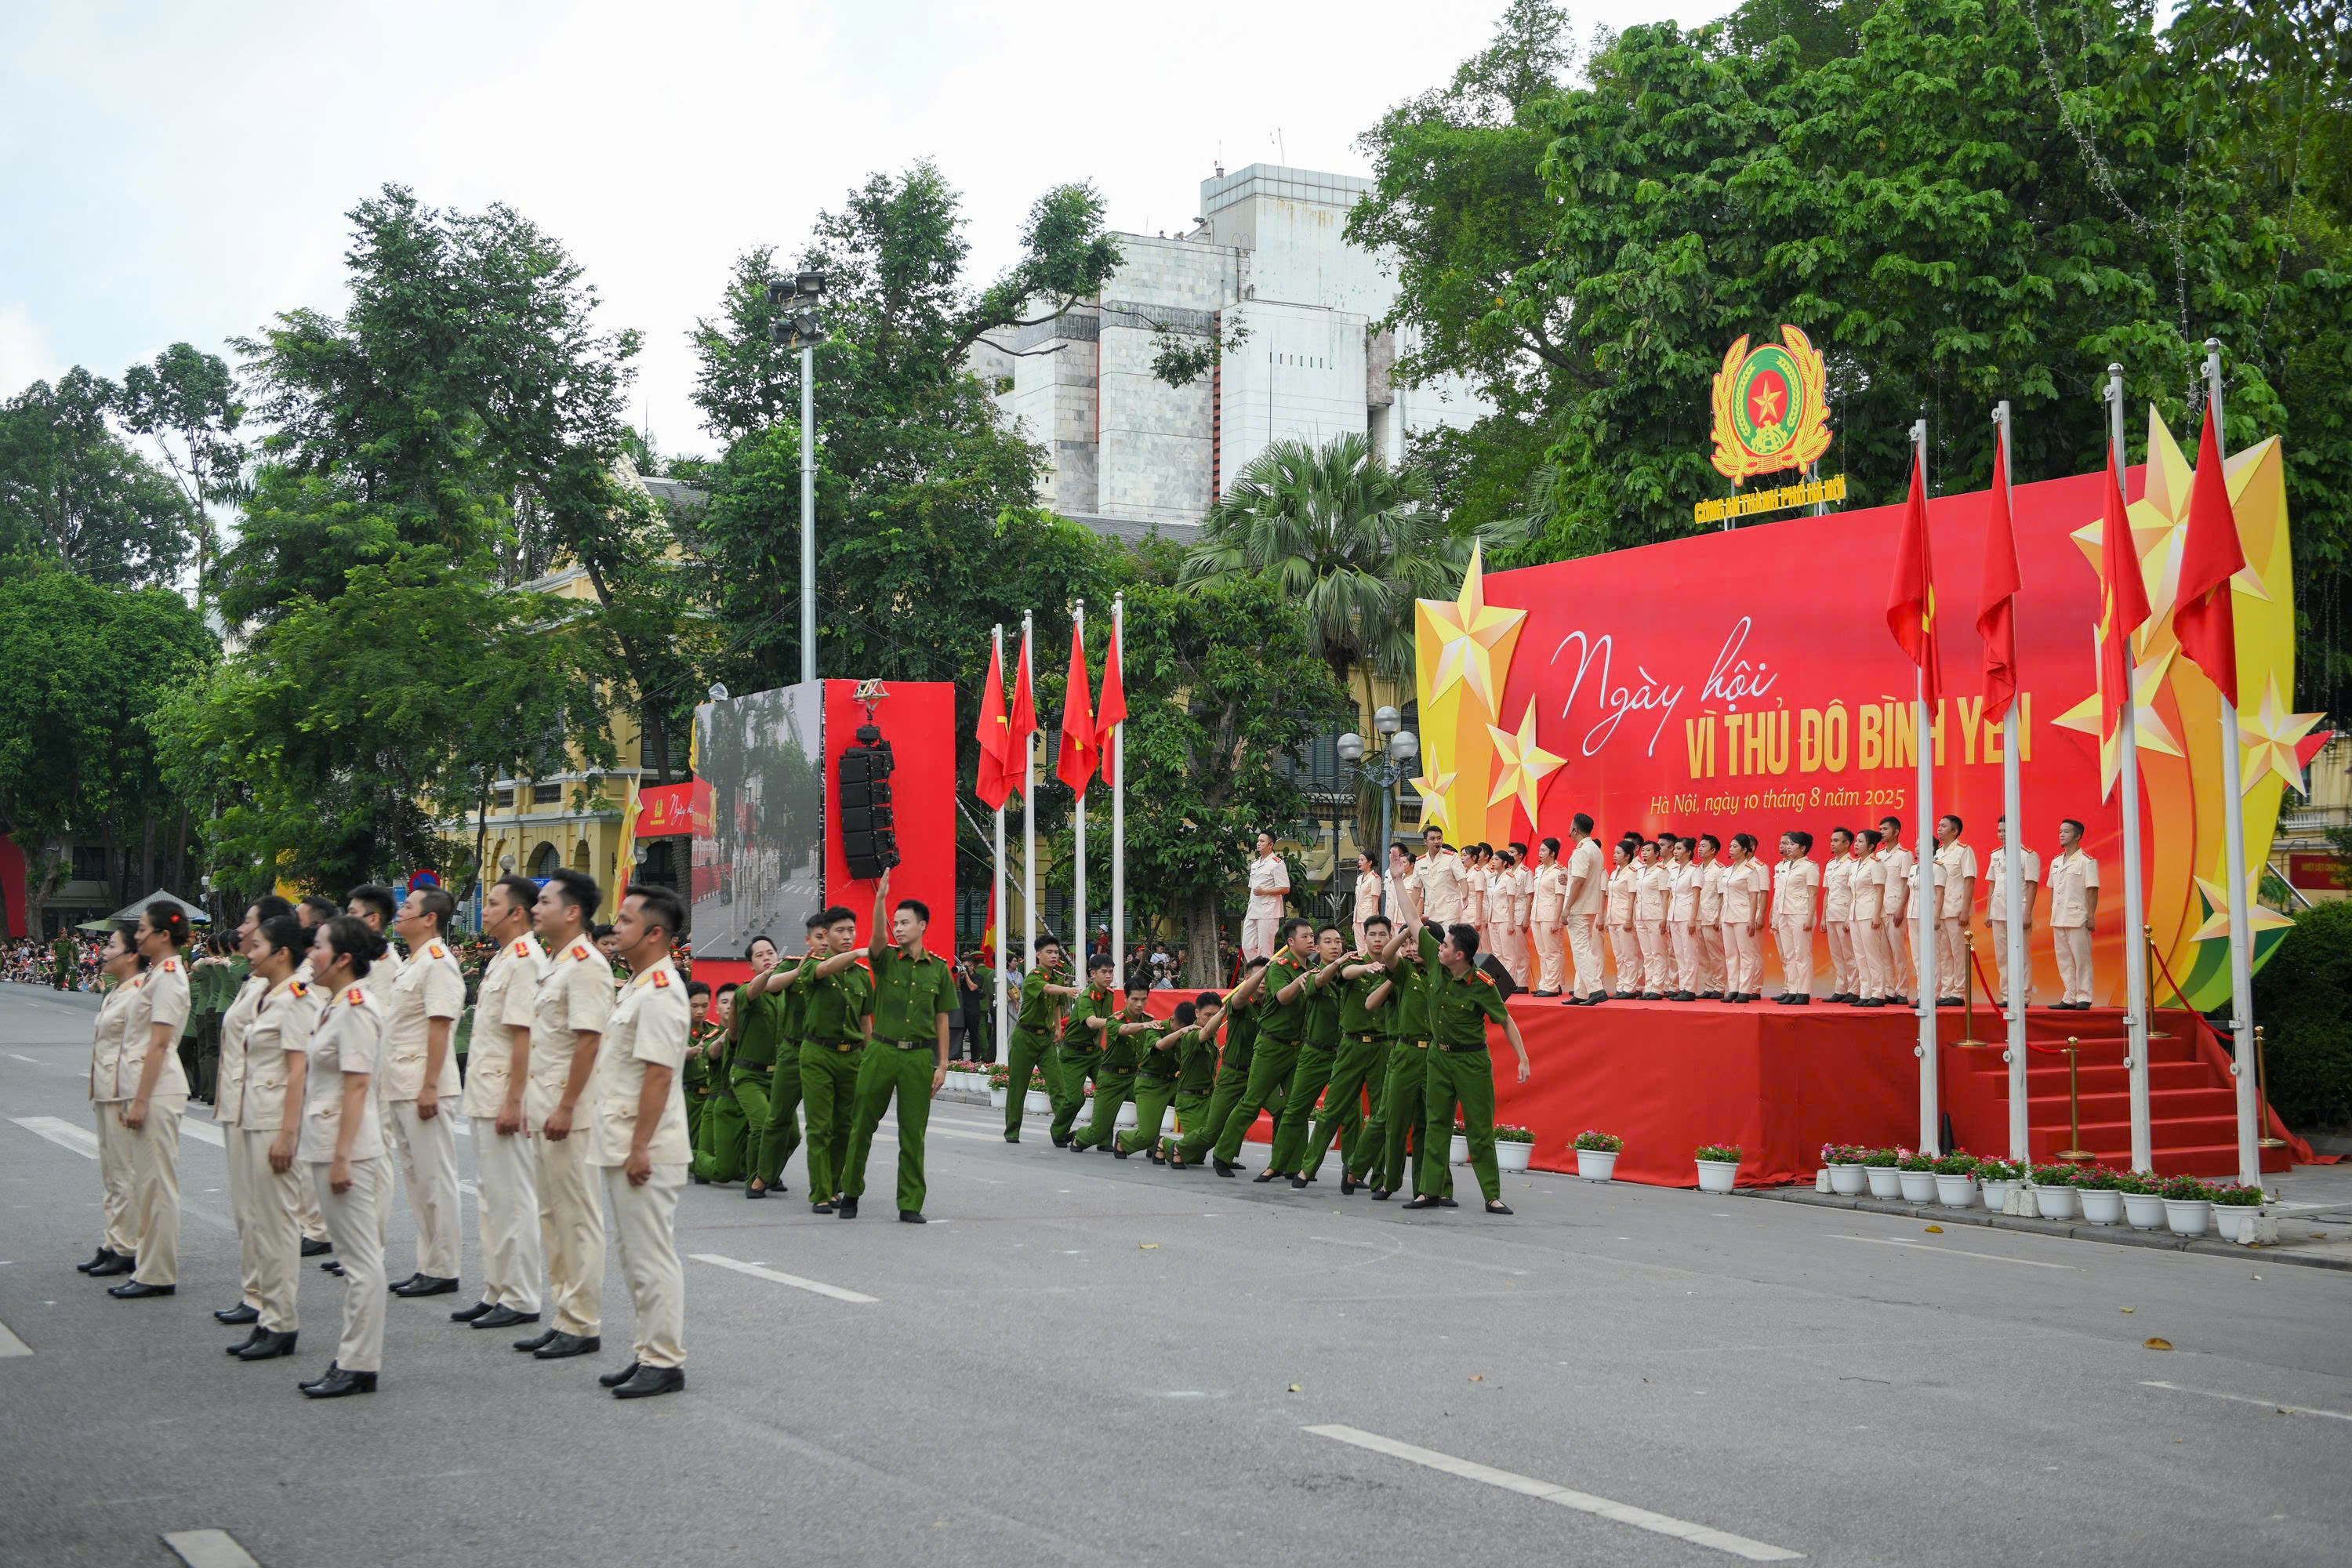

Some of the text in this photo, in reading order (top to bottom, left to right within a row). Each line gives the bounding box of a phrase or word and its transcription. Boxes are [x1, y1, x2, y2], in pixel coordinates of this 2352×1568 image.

[1694, 499, 1725, 524] CÔNG
[1725, 495, 1740, 517] AN
[1740, 486, 1779, 514] THÀNH
[1551, 616, 1777, 757] Ngày hội
[1686, 709, 1717, 779] VÌ
[1724, 697, 1790, 776] THỦ
[1798, 698, 1848, 772] ĐÔ
[1650, 786, 1905, 816] Hà Nội, ngày 10 tháng 8 năm 2025
